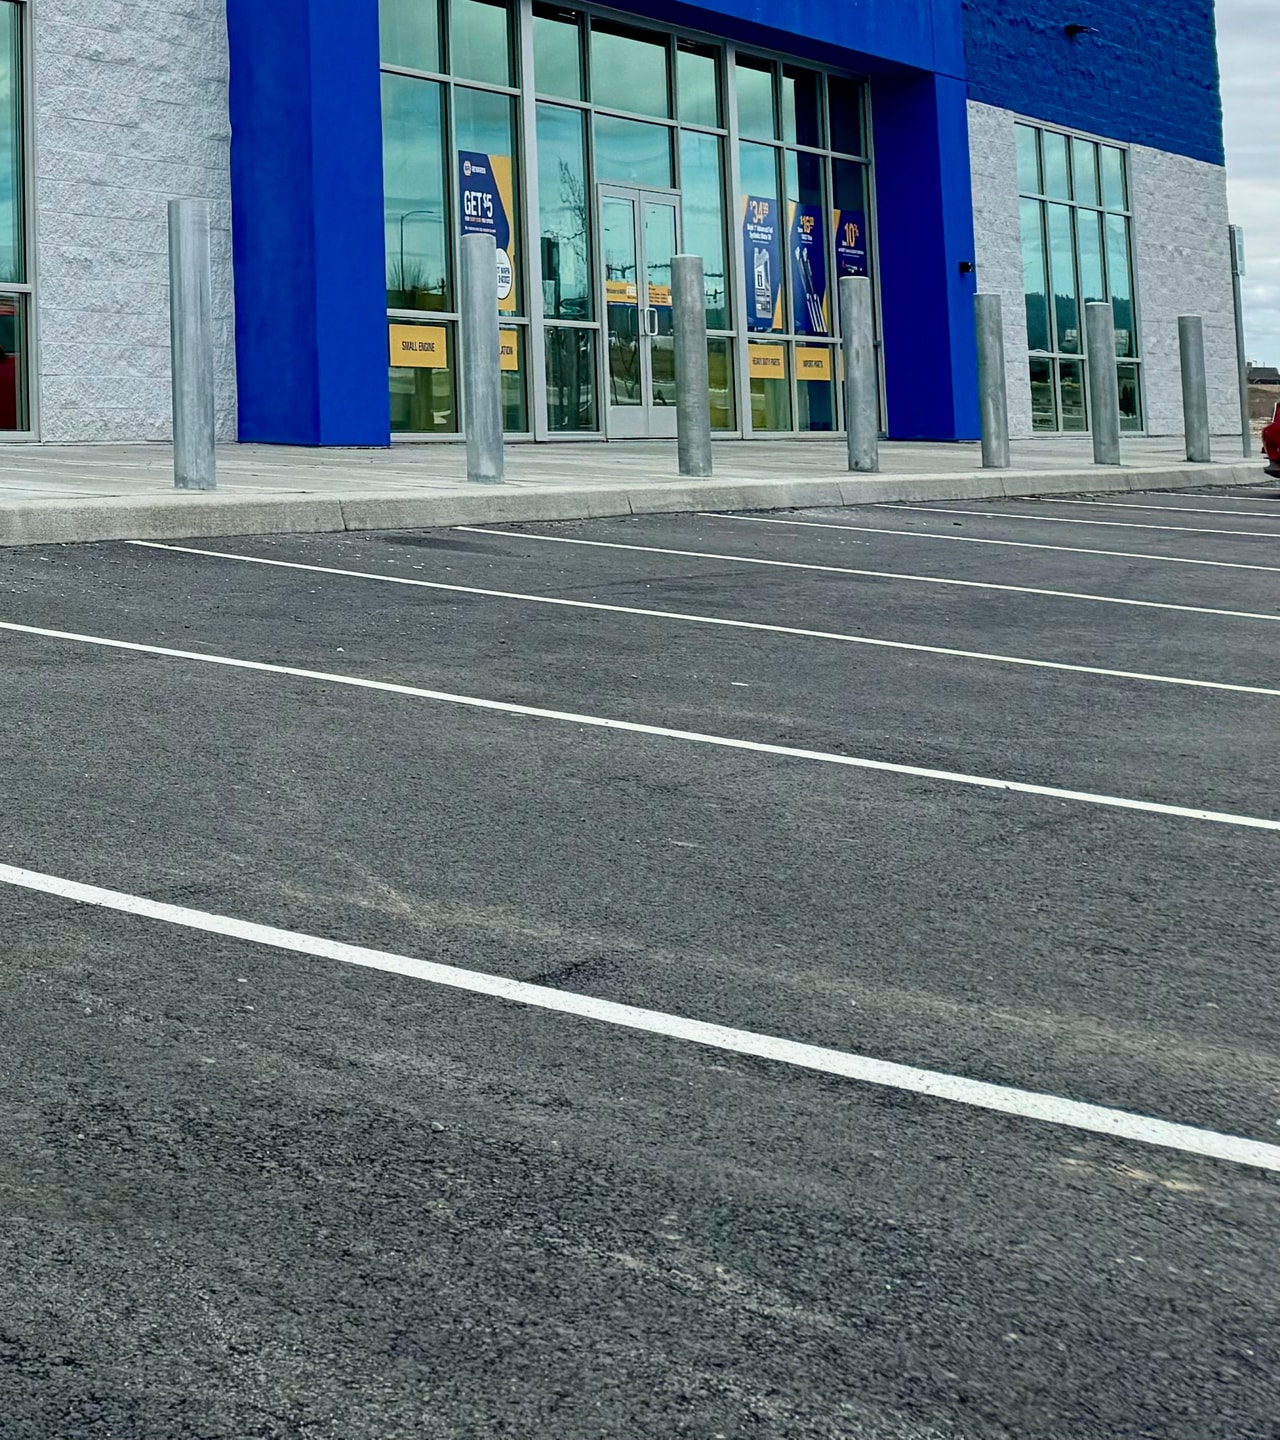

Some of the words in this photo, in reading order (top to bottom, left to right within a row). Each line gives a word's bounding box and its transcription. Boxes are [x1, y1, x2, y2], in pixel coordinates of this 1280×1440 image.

[464, 190, 482, 216] GET
[483, 192, 493, 218] $5
[401, 340, 418, 352] SMALL
[418, 342, 436, 353] ENGINE
